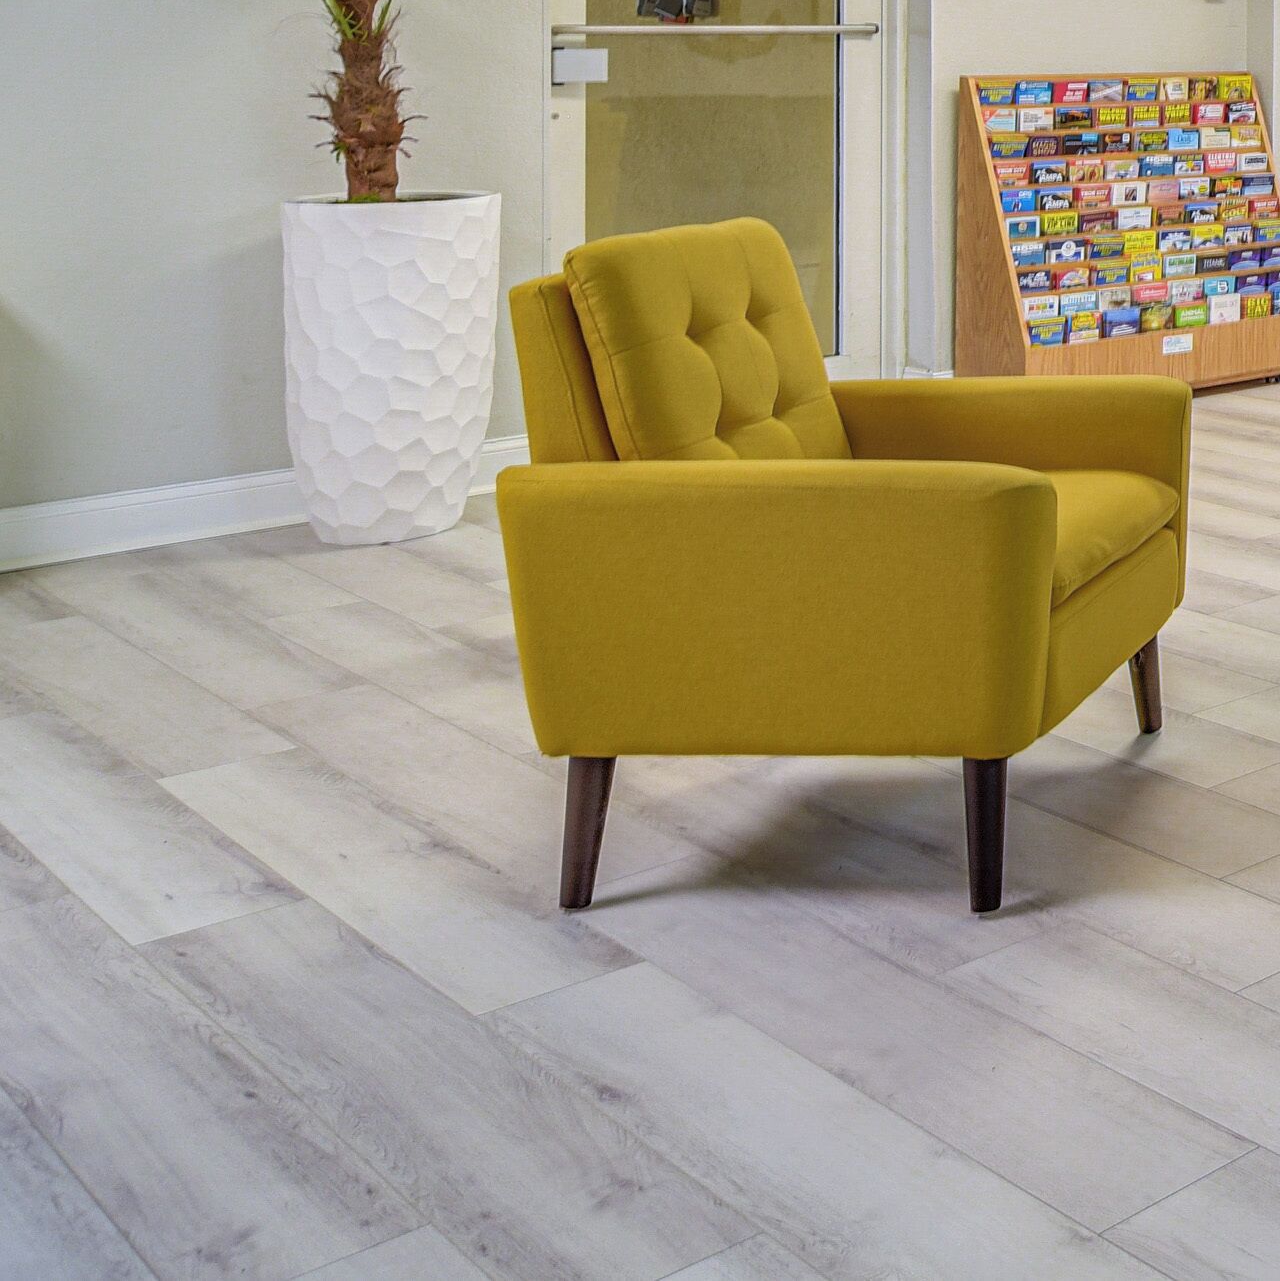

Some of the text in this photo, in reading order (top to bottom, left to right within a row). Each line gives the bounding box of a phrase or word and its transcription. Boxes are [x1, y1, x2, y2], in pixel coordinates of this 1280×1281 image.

[1222, 208, 1246, 217] GOLF
[1047, 219, 1060, 228] ZIP
[1060, 218, 1076, 227] LINE
[1247, 297, 1269, 307] BIG
[1180, 308, 1205, 317] ANIMAL
